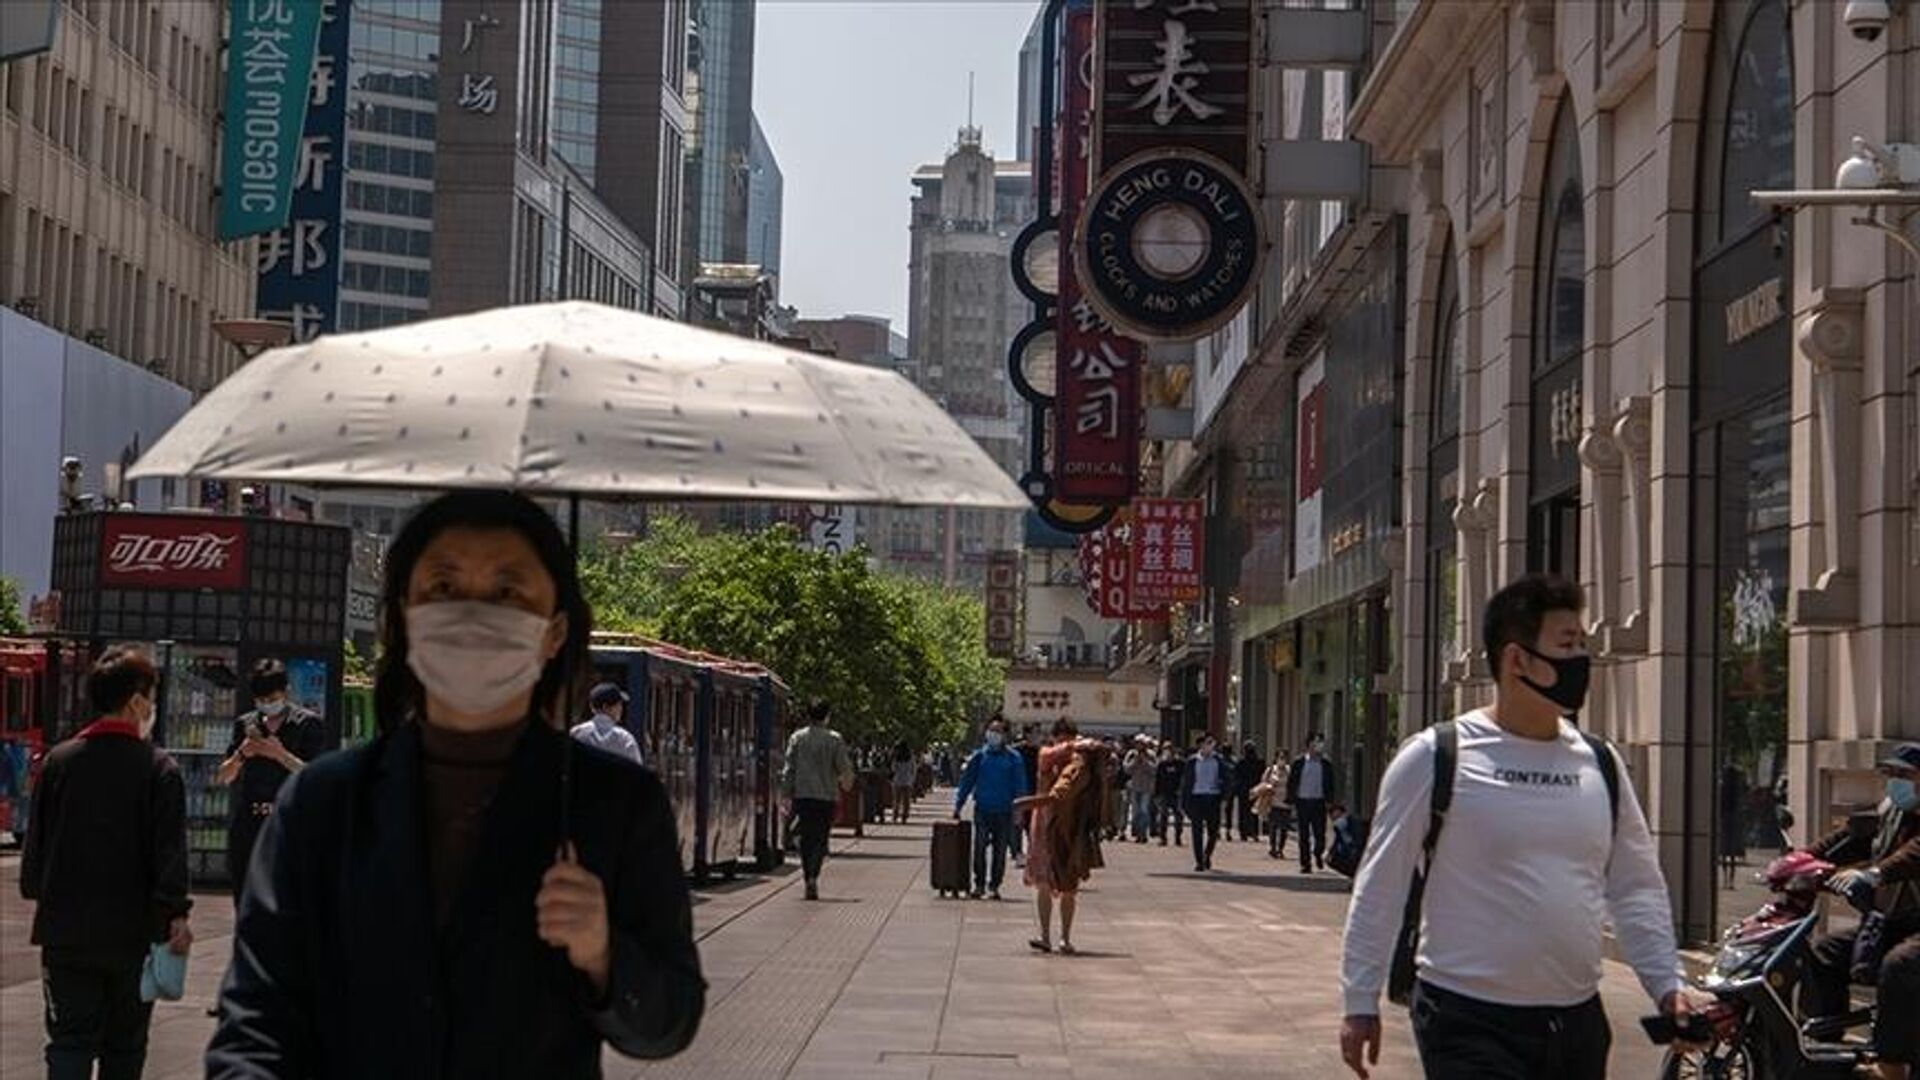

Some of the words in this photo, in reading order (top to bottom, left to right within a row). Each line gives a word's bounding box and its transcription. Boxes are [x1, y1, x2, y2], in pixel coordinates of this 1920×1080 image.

[459, 14, 498, 113] 广场
[1105, 168, 1171, 222] HENG
[1184, 169, 1240, 222] DALI
[1099, 231, 1139, 300] CLOCKS
[1142, 293, 1177, 312] AND
[1187, 238, 1243, 307] WATCHES
[1064, 461, 1124, 476] OPTICAL
[109, 532, 238, 572] 可口可乐
[1493, 768, 1582, 787] CONTRAST
